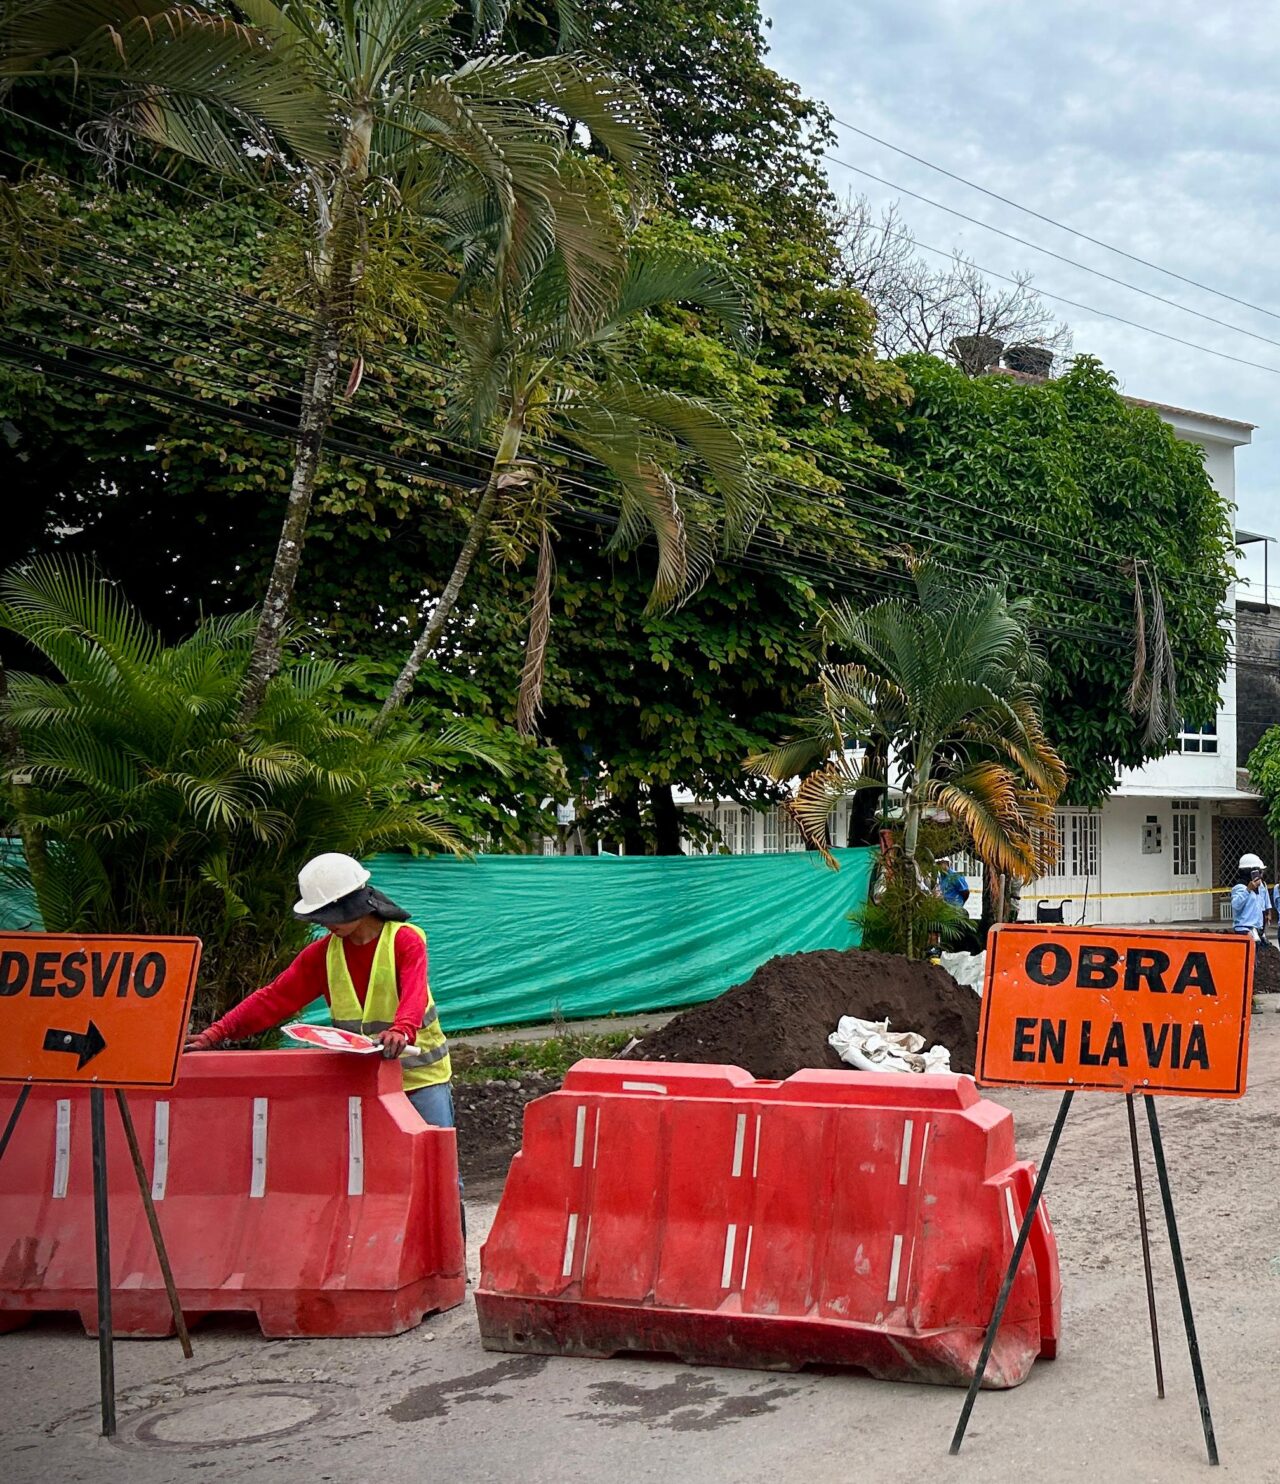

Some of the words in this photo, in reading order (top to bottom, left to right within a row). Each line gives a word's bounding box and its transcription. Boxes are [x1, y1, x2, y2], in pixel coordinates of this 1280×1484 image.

[0, 951, 166, 998] DESVIO
[1025, 943, 1217, 996] OBRA
[1012, 1017, 1066, 1064] EN
[1079, 1020, 1128, 1067] LA
[1143, 1022, 1210, 1070] VIA
